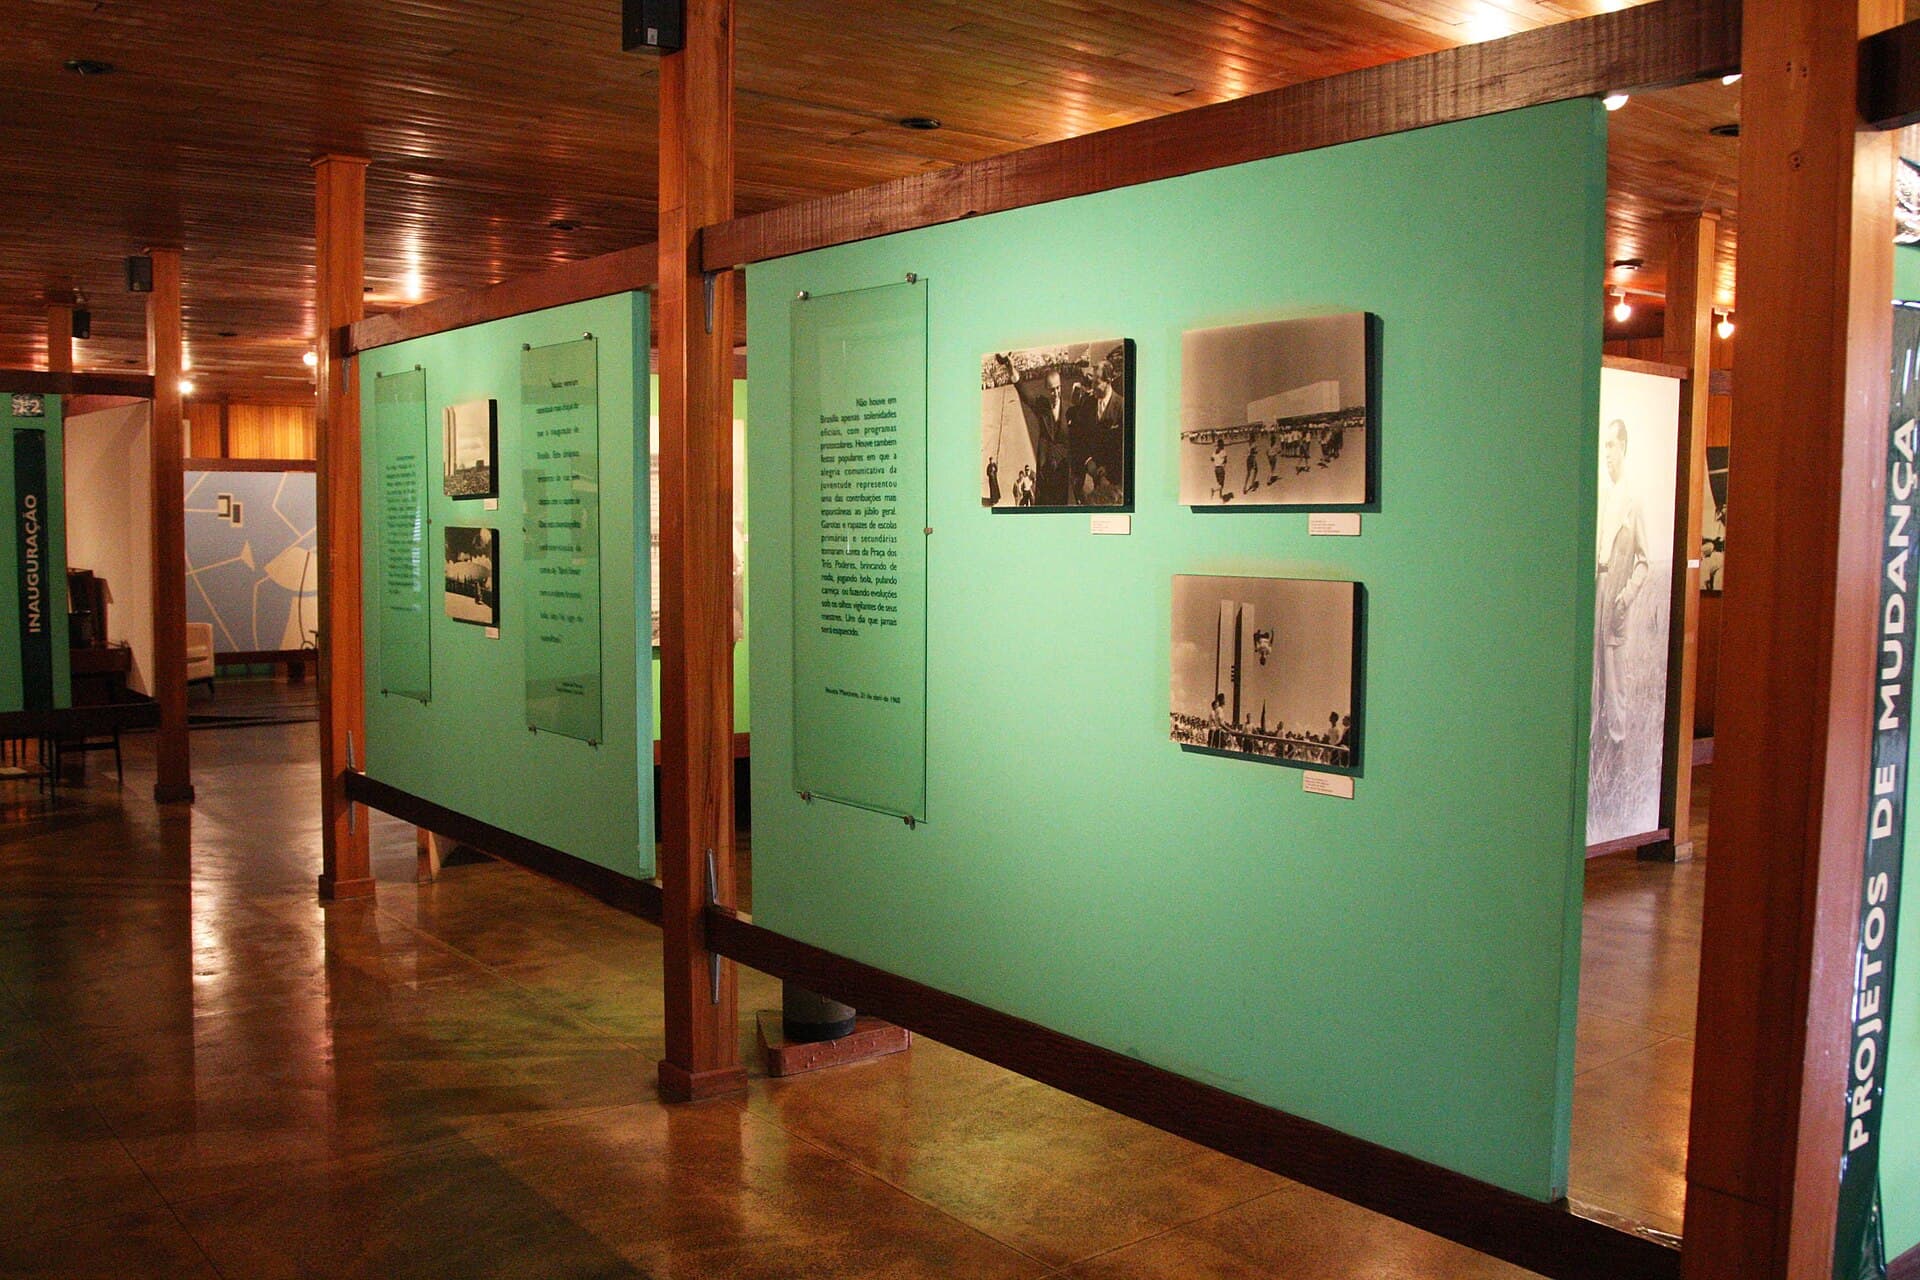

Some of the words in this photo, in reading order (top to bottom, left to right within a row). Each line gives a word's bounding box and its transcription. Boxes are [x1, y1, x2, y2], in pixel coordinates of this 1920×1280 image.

[856, 398, 867, 407] Não
[869, 398, 885, 406] houve
[841, 415, 859, 424] apenas
[864, 410, 897, 420] solenidades
[864, 426, 897, 436] programas
[855, 440, 873, 448] Houve
[838, 453, 863, 464] populares
[880, 454, 890, 463] que
[821, 468, 840, 478] alegria
[845, 467, 884, 476] comunicativa
[890, 466, 897, 474] da
[821, 481, 852, 491] juventude
[856, 481, 897, 490] representou
[846, 494, 882, 504] contribuições
[848, 523, 867, 531] rapazes
[869, 521, 877, 529] de
[878, 521, 897, 529] escolas
[861, 534, 897, 543] secundárias
[871, 548, 885, 558] Praça
[887, 548, 897, 557] dos
[23, 494, 41, 633] INAUGURAÇÃO
[860, 561, 887, 570] brincando
[890, 563, 897, 571] de
[837, 574, 857, 584] jogando
[860, 575, 872, 583] bola,
[876, 576, 897, 585] pulando
[1879, 418, 1918, 731] MUDANÇA
[850, 587, 869, 597] fazendo
[871, 589, 897, 599] evoluções
[839, 601, 852, 609] olhos
[854, 602, 877, 612] vigilantes
[878, 603, 884, 611] de
[846, 614, 856, 622] Um
[868, 618, 878, 626] que
[881, 618, 897, 628] jamais
[1872, 764, 1896, 840] DE
[1849, 872, 1889, 1152] PROJETOS
